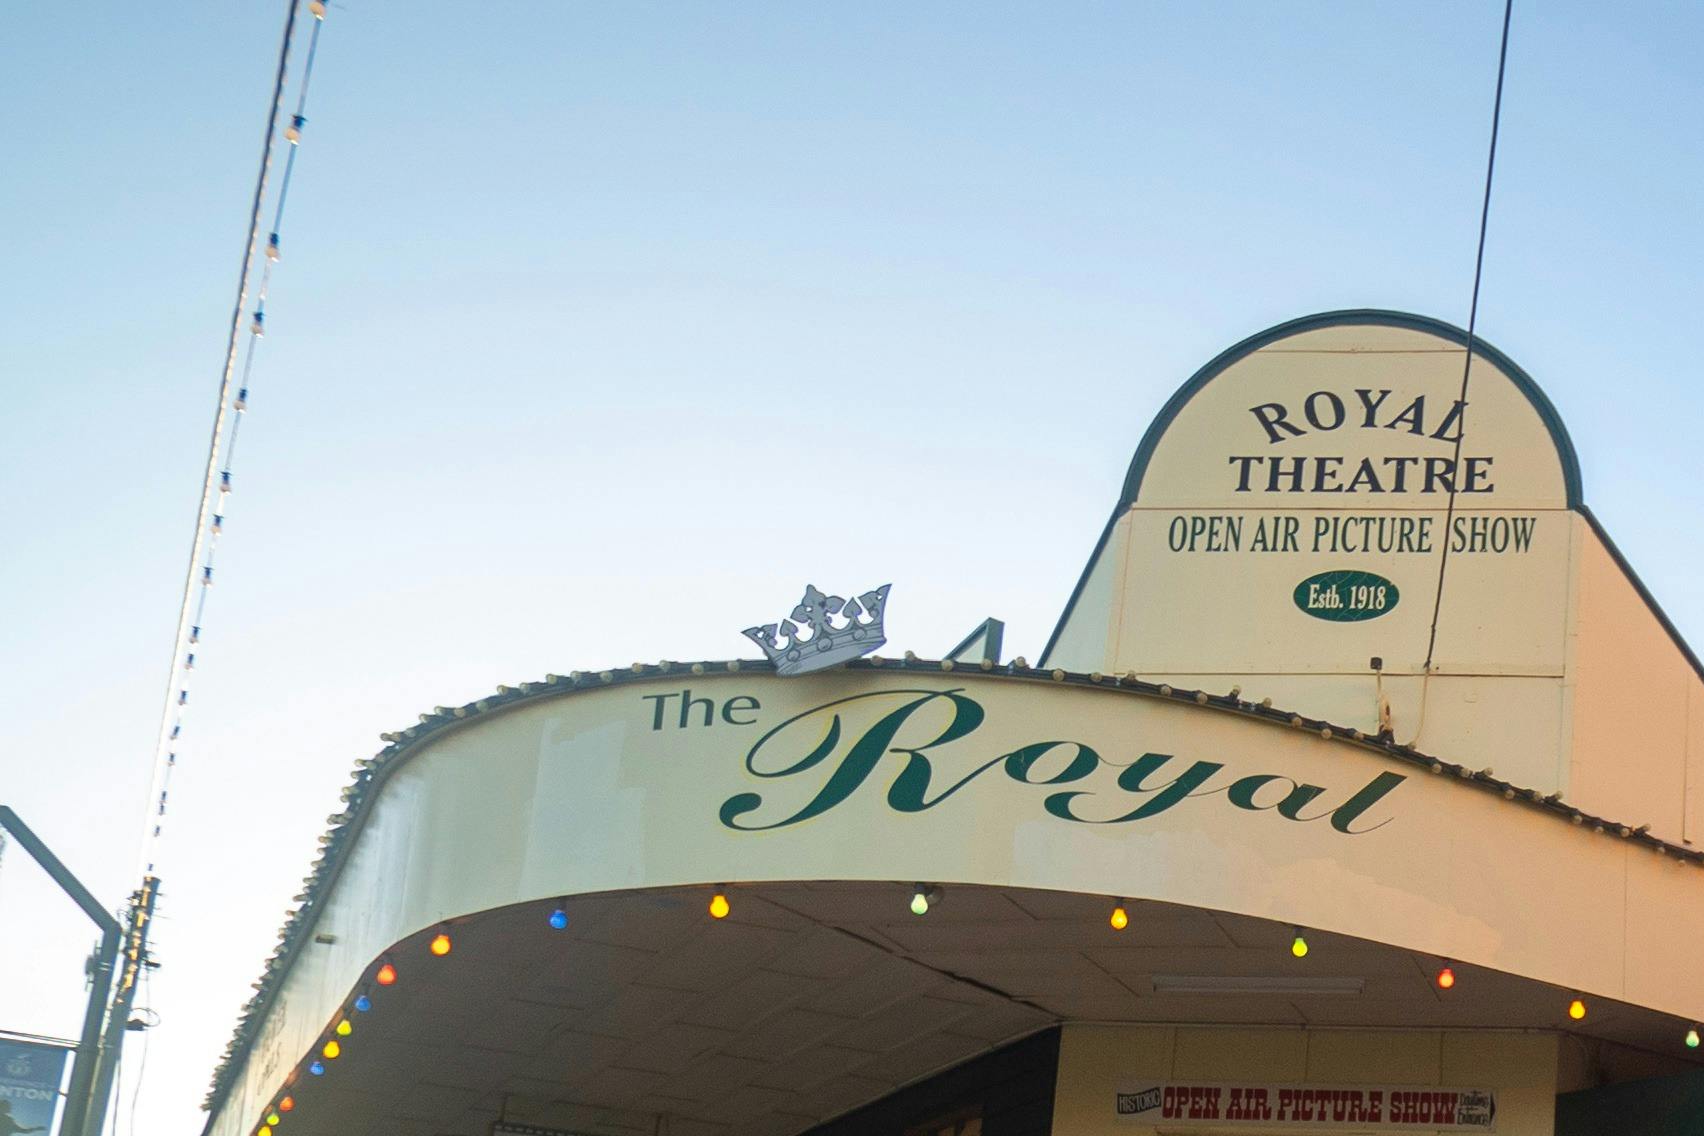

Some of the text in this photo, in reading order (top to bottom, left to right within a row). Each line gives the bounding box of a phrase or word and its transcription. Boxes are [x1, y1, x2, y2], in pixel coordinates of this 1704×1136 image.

[1249, 388, 1470, 445] ROYAL
[1229, 455, 1495, 494] THEATRE
[1168, 515, 1537, 554] OPEN AIR PICTURE SHOW
[1308, 585, 1387, 611] Estb. 1918
[641, 686, 1409, 836] The Royal
[1118, 1086, 1458, 1125] HISTORIC OPEN AIR PICTURE SHOW
